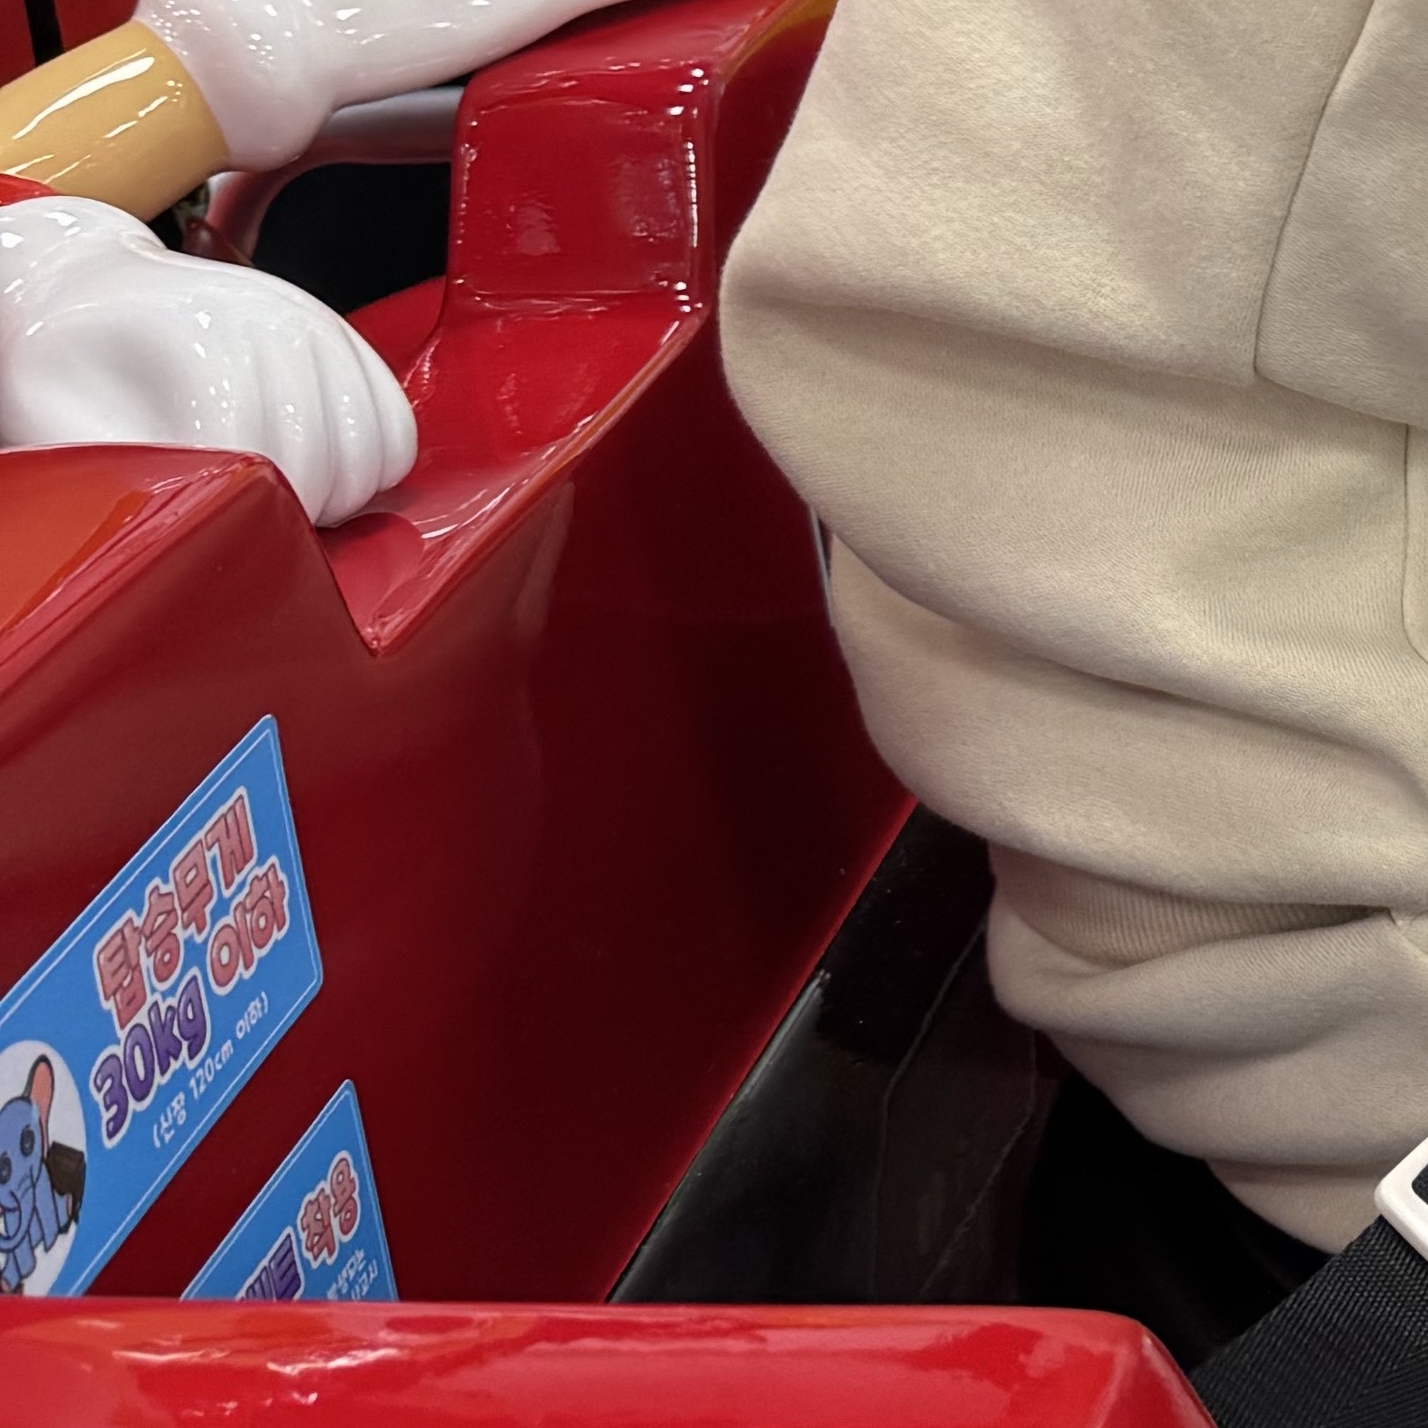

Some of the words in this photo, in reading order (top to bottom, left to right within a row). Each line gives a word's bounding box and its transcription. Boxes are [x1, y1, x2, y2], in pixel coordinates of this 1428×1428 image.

[97, 794, 253, 1028] 탑승무게
[94, 974, 208, 1139] 30kg
[209, 865, 288, 989] 이하
[188, 1042, 234, 1100] 120cm
[302, 1157, 360, 1259] 착용
